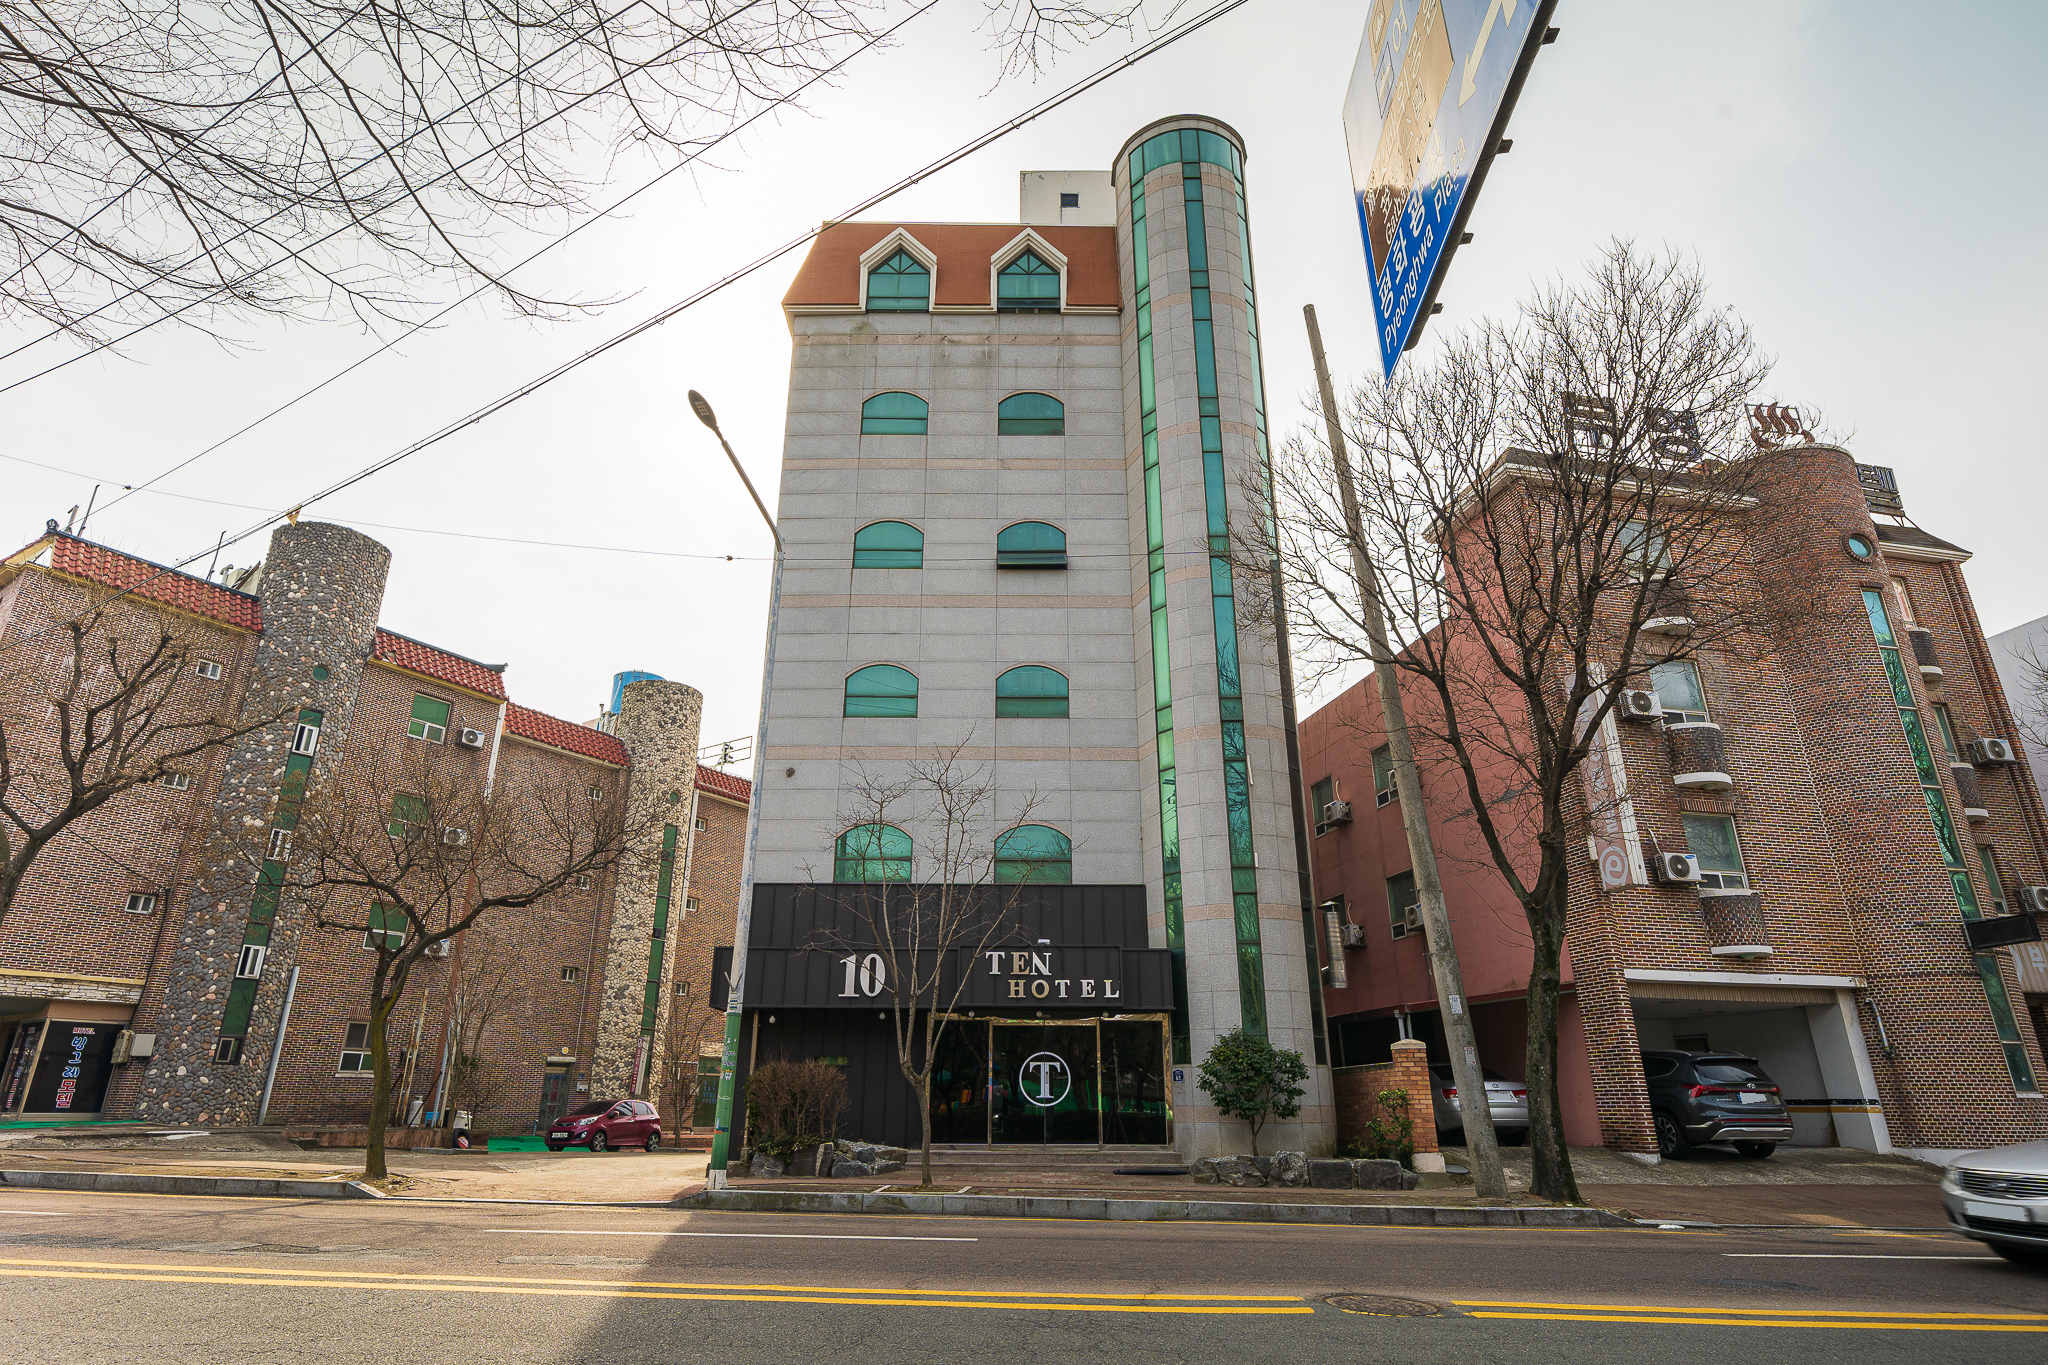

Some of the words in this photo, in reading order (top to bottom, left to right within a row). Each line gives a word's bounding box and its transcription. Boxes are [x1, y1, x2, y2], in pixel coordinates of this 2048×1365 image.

[1384, 223, 1434, 354] Pyeonghwa
[1434, 136, 1467, 224] Plaza
[837, 952, 886, 998] 10
[985, 951, 1052, 976] TEN
[1007, 979, 1120, 999] HOTEL
[72, 1027, 95, 1035] MOTEL
[1029, 1061, 1061, 1099] T
